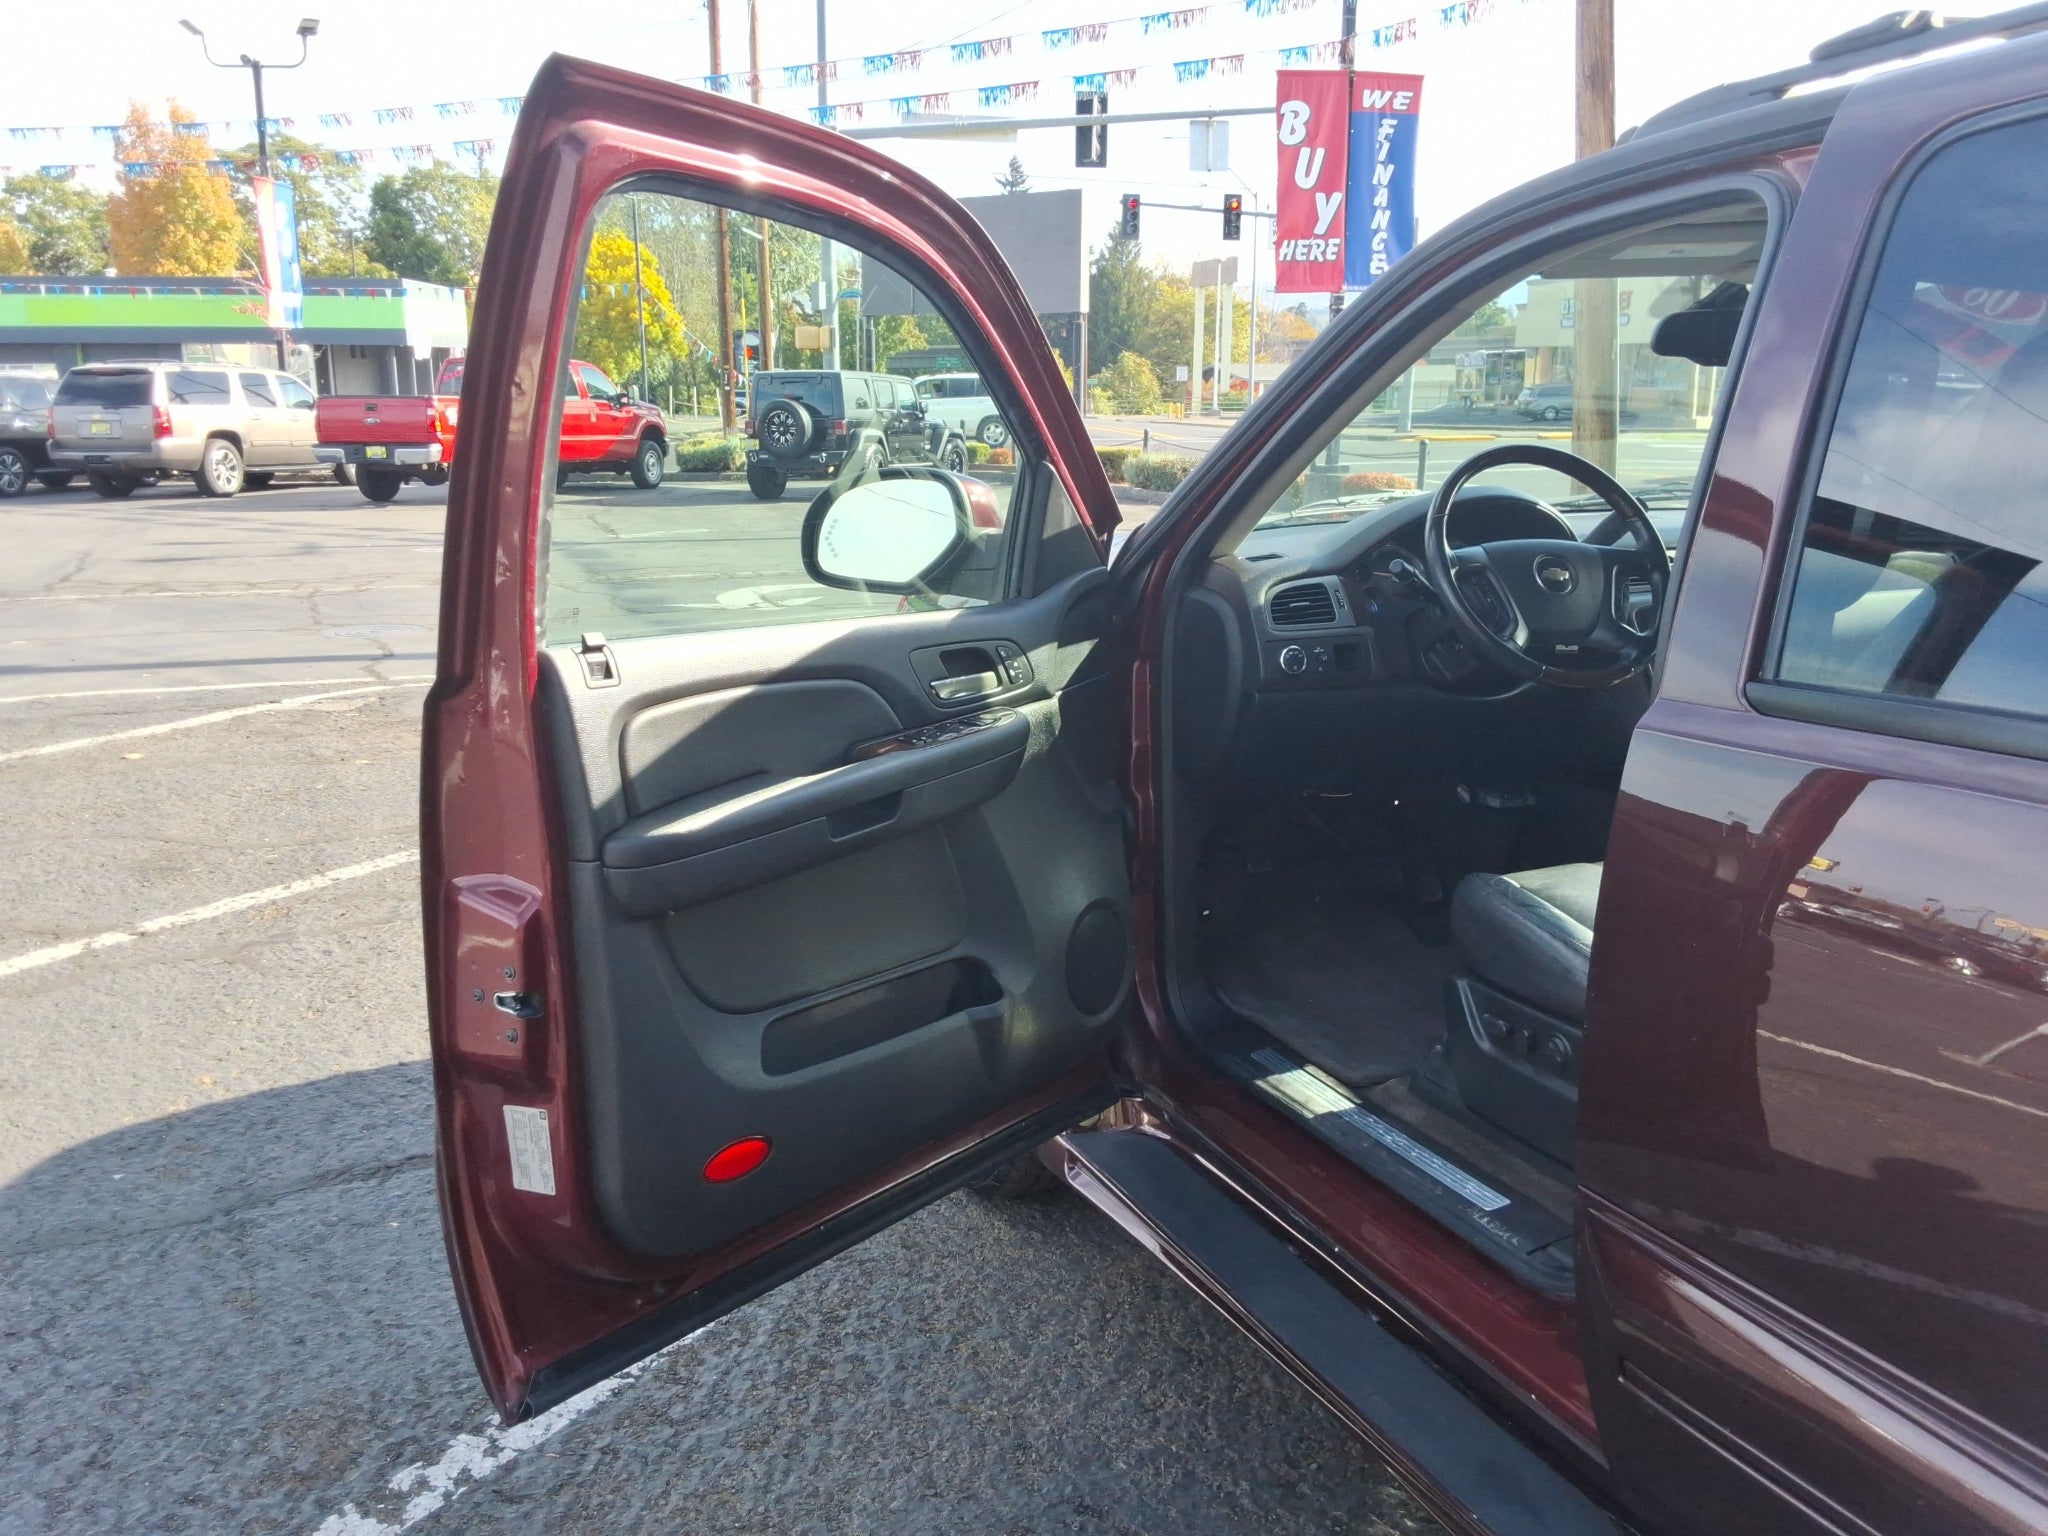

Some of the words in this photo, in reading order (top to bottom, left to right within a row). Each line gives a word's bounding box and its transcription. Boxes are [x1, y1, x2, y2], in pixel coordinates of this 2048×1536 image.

[1362, 89, 1414, 110] WE
[1279, 100, 1343, 236] BUY
[1369, 118, 1398, 276] FINANCE
[1278, 238, 1342, 263] HERE
